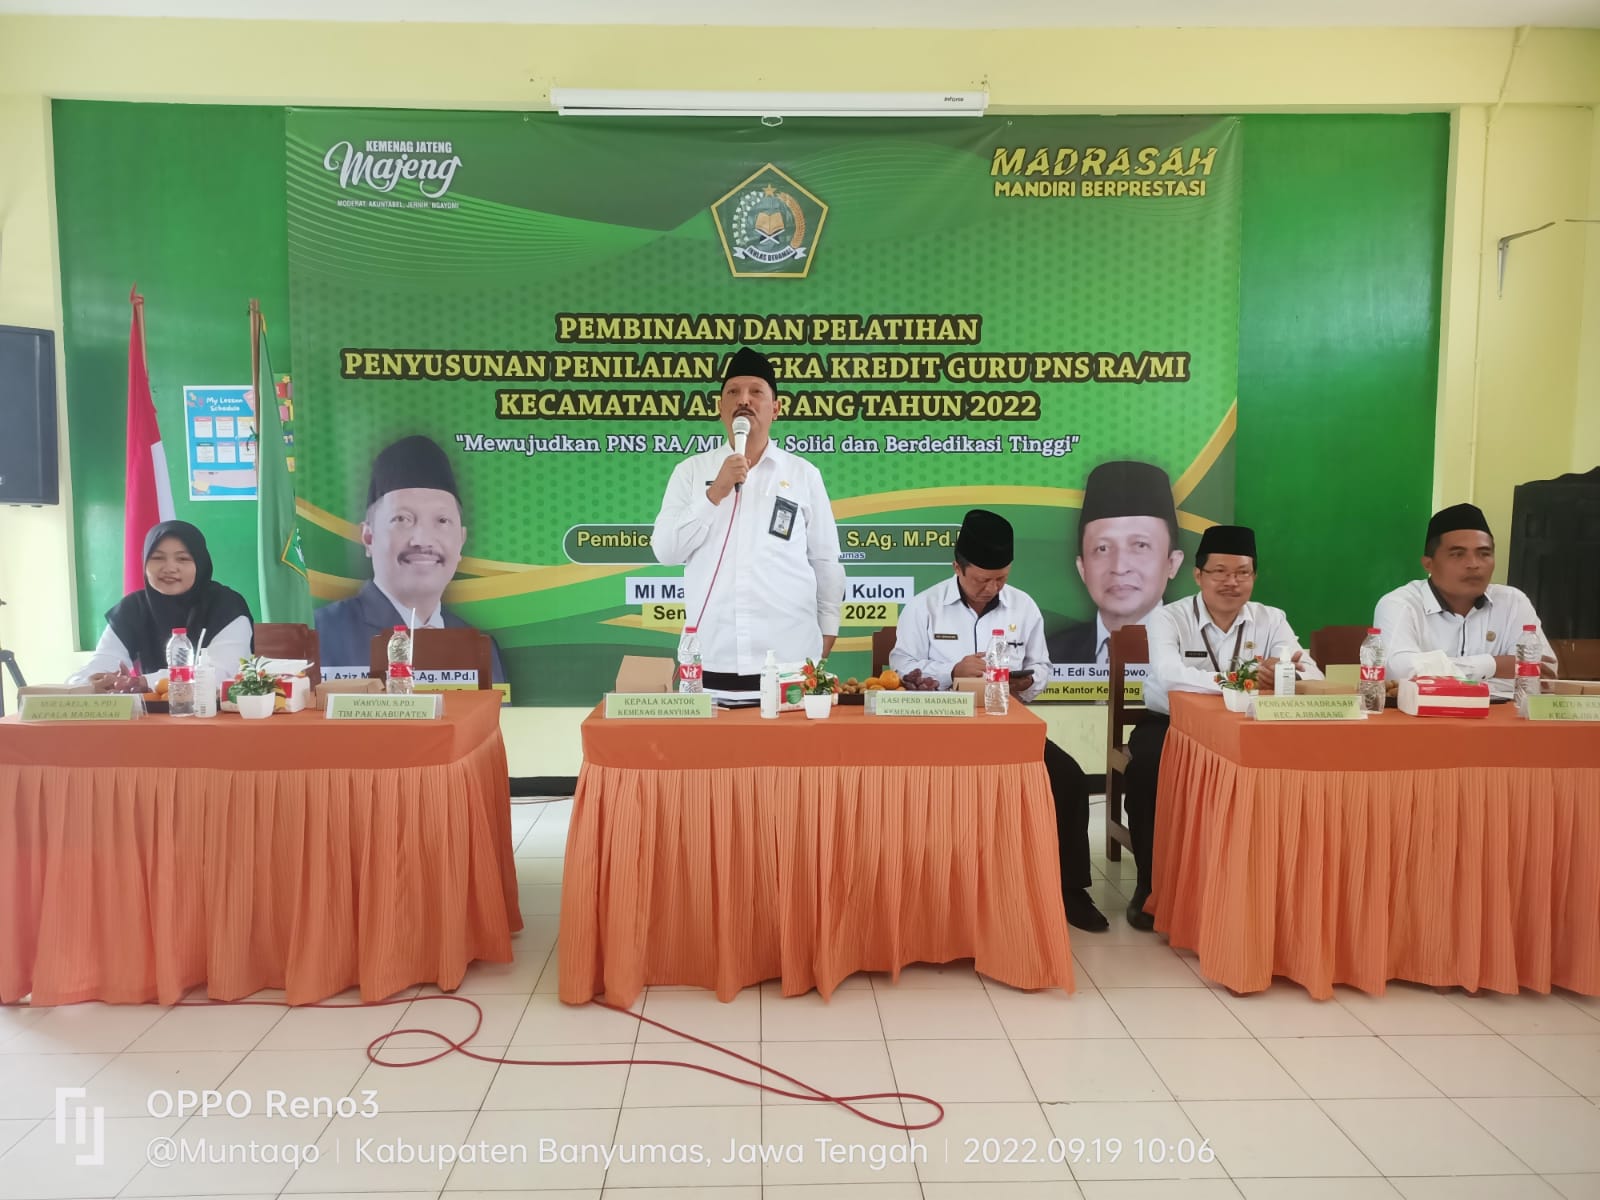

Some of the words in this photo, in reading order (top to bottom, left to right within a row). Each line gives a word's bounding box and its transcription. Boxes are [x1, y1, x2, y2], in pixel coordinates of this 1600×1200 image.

[365, 140, 413, 153] KEMENAG
[415, 141, 453, 154] JATENG
[323, 140, 463, 199] Majeng
[990, 147, 1218, 177] MADRASAH
[994, 181, 1076, 198] MANDIRI
[1081, 180, 1207, 198] BERPRESTASI
[559, 317, 735, 340] PEMBINAAN
[743, 317, 803, 341] DAN
[812, 318, 978, 341] PELATIHAN
[344, 352, 546, 378] PENYUSUNAN
[554, 354, 714, 379] PENILAIAN
[830, 356, 940, 380] KREDIT
[947, 356, 1027, 379] GURU
[1034, 357, 1090, 379] PNS
[1097, 355, 1186, 381] RA/MI
[500, 393, 681, 417] KECAMATAN
[862, 395, 962, 418] TAHUN
[970, 395, 1037, 418] 2022
[455, 434, 601, 456] "Mewujudkan
[605, 435, 648, 452] PNS
[653, 435, 724, 455] RA/MI
[784, 435, 835, 453] Solid
[841, 435, 880, 453] dan
[885, 435, 1003, 453] Berdedikasi
[1008, 435, 1080, 457] Tinggi"
[847, 530, 898, 550] S.Ag.
[634, 584, 655, 599] MI
[852, 583, 905, 599] Kulon
[845, 605, 887, 620] 2022
[441, 671, 476, 682] M.Pd.I
[681, 666, 699, 679] Vit
[1053, 666, 1064, 677] H.
[1067, 666, 1086, 677] Edi
[1362, 666, 1383, 681] Vit
[1062, 685, 1094, 695] Kantor
[624, 698, 658, 706] KEPALA
[661, 697, 696, 705] KANTOR
[1307, 700, 1354, 708] MADRASAH
[338, 710, 353, 718] TIM
[355, 710, 373, 718] PAK
[375, 710, 428, 718] KABUPATEN
[617, 708, 656, 716] KEMENAG
[657, 708, 701, 716] BANYUMAS
